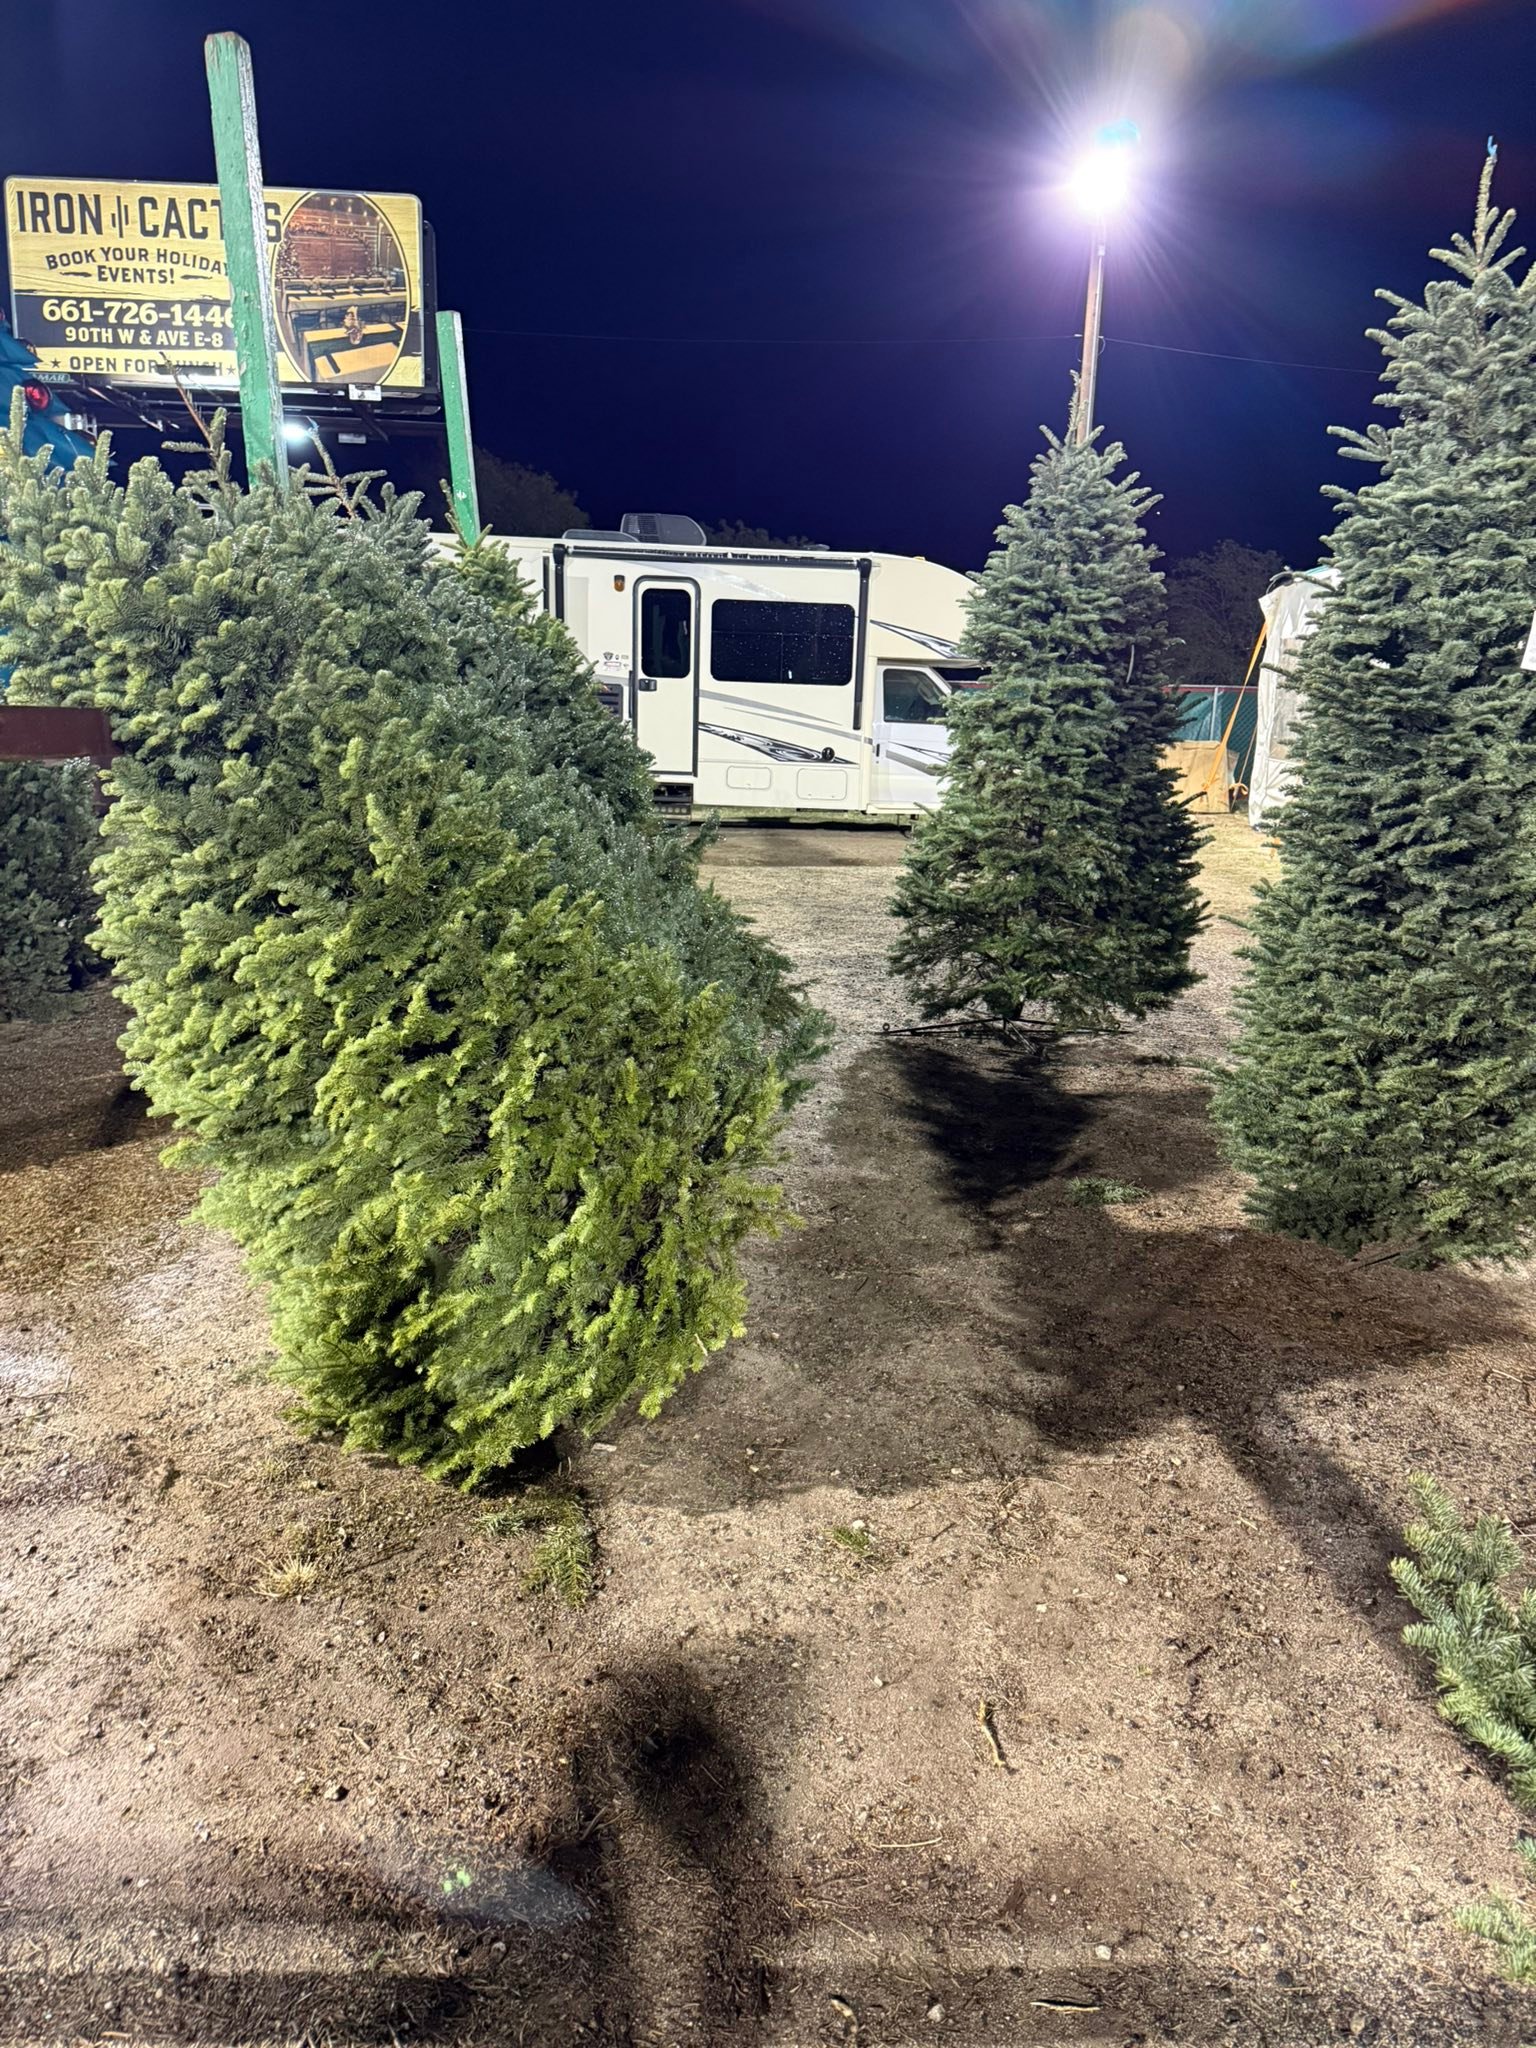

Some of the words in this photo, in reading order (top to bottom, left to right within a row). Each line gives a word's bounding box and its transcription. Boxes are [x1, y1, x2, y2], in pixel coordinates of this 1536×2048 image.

[16, 191, 103, 235] IRON
[138, 196, 282, 243] CACTS
[45, 249, 97, 270] BOOK
[100, 247, 149, 262] YOUR
[97, 265, 175, 285] EVENTS!
[65, 326, 113, 343] 90TH
[117, 328, 135, 344] W
[139, 329, 152, 345] &
[156, 330, 190, 346] AVE
[194, 331, 224, 348] E-8
[69, 356, 117, 372] OPEN
[124, 358, 158, 373] FOR
